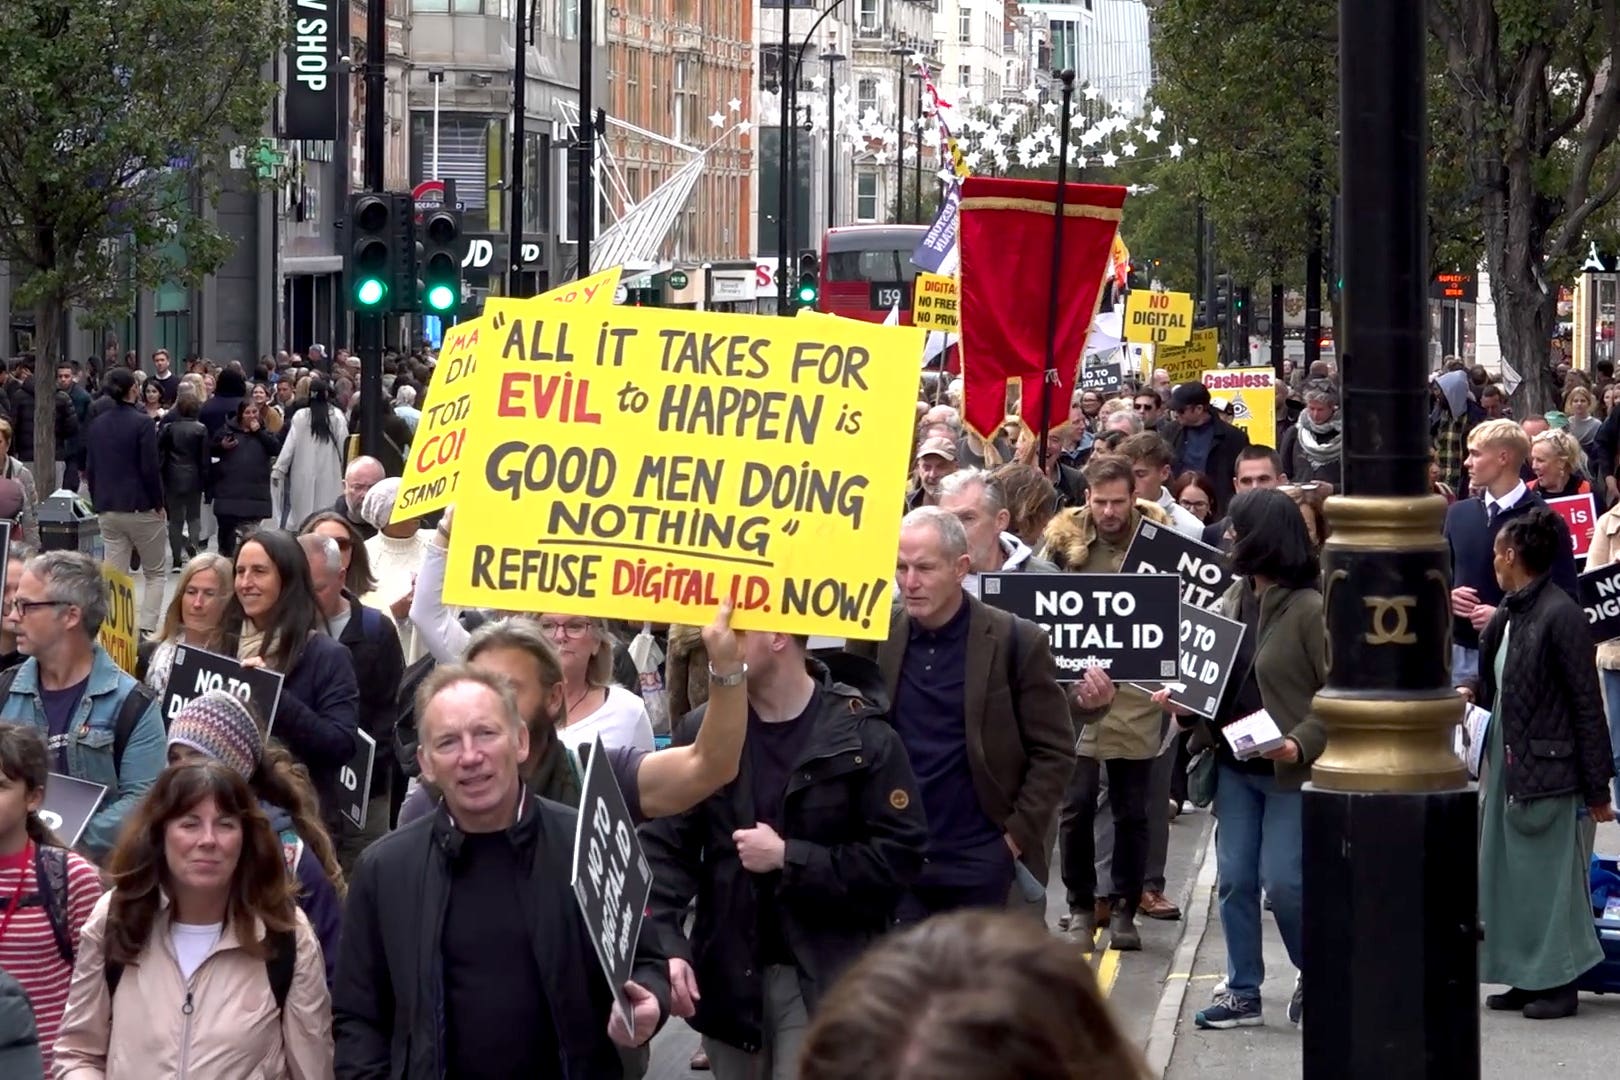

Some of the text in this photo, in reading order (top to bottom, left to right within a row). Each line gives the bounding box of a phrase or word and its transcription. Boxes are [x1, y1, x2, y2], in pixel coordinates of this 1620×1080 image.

[297, 18, 328, 91] SHOP
[878, 289, 900, 306] 139
[925, 281, 957, 294] DIGITA
[918, 296, 932, 308] NO
[1149, 295, 1169, 309] NO
[917, 311, 931, 323] NO
[1133, 311, 1186, 328] DIGITAL
[659, 328, 772, 379] TAKES
[791, 342, 870, 391] FOR
[1083, 368, 1109, 380] O TO
[1107, 375, 1118, 385] ID
[617, 381, 650, 414] to
[658, 384, 825, 445] HAPPEN
[835, 403, 863, 435] is
[485, 440, 618, 501] GOOD
[633, 455, 726, 505] MEN
[399, 475, 447, 510] STAND
[1570, 508, 1588, 524] is
[1177, 551, 1222, 585] NO
[471, 544, 603, 598] REFUSE
[781, 577, 888, 629] NOW!
[1035, 590, 1136, 617] NO TO
[1132, 623, 1164, 649] ID
[1193, 624, 1216, 652] TO
[194, 668, 224, 697] NO
[1199, 659, 1220, 685] ID
[340, 765, 357, 791] ID
[588, 796, 611, 899] NO TO
[601, 853, 626, 973] DIGITAL
[615, 819, 632, 869] ID
